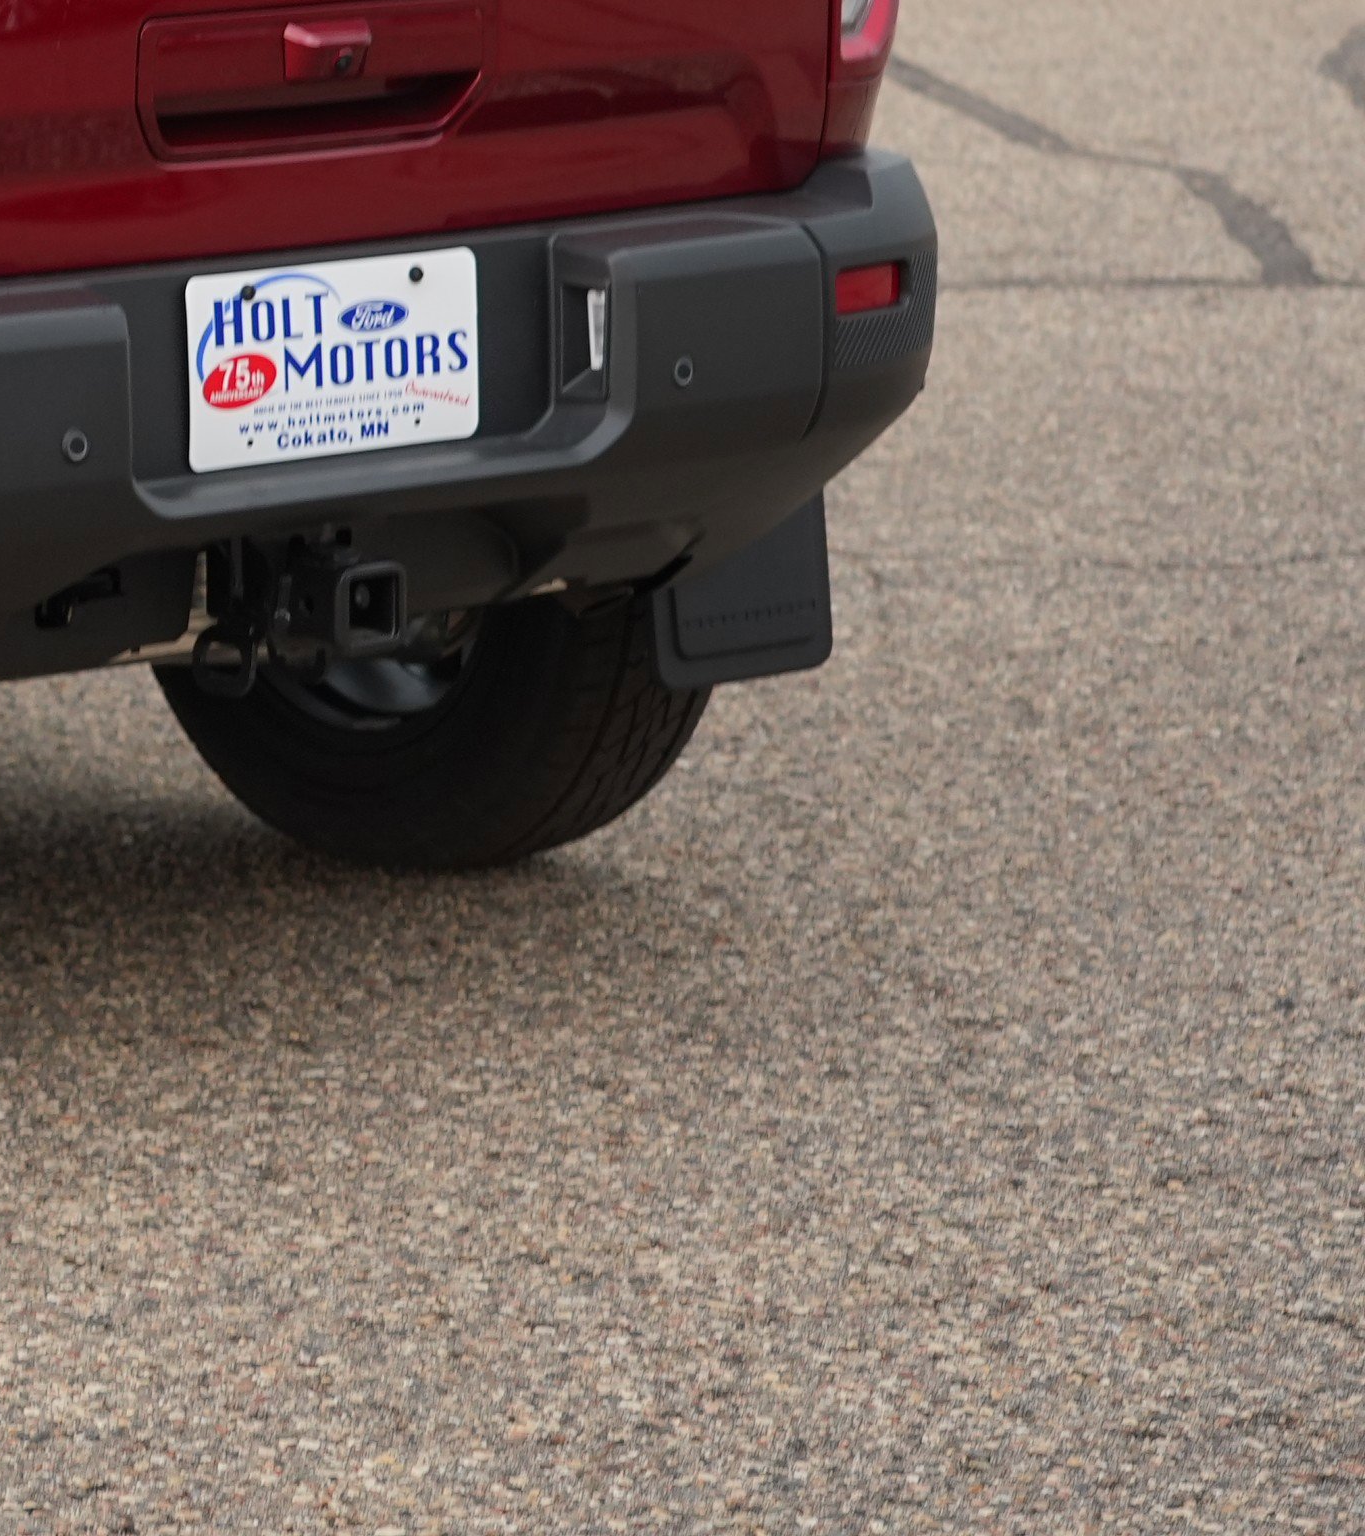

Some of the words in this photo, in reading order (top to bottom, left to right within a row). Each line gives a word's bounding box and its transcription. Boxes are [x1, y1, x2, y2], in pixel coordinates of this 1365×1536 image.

[214, 290, 329, 346] HOLT
[219, 357, 266, 393] 75th
[284, 330, 468, 393] MOTORS
[209, 386, 264, 404] ANNIVERSARY
[239, 404, 424, 434] www.holtmotors.com
[277, 427, 353, 449] Cokato,
[360, 421, 389, 438] MN
